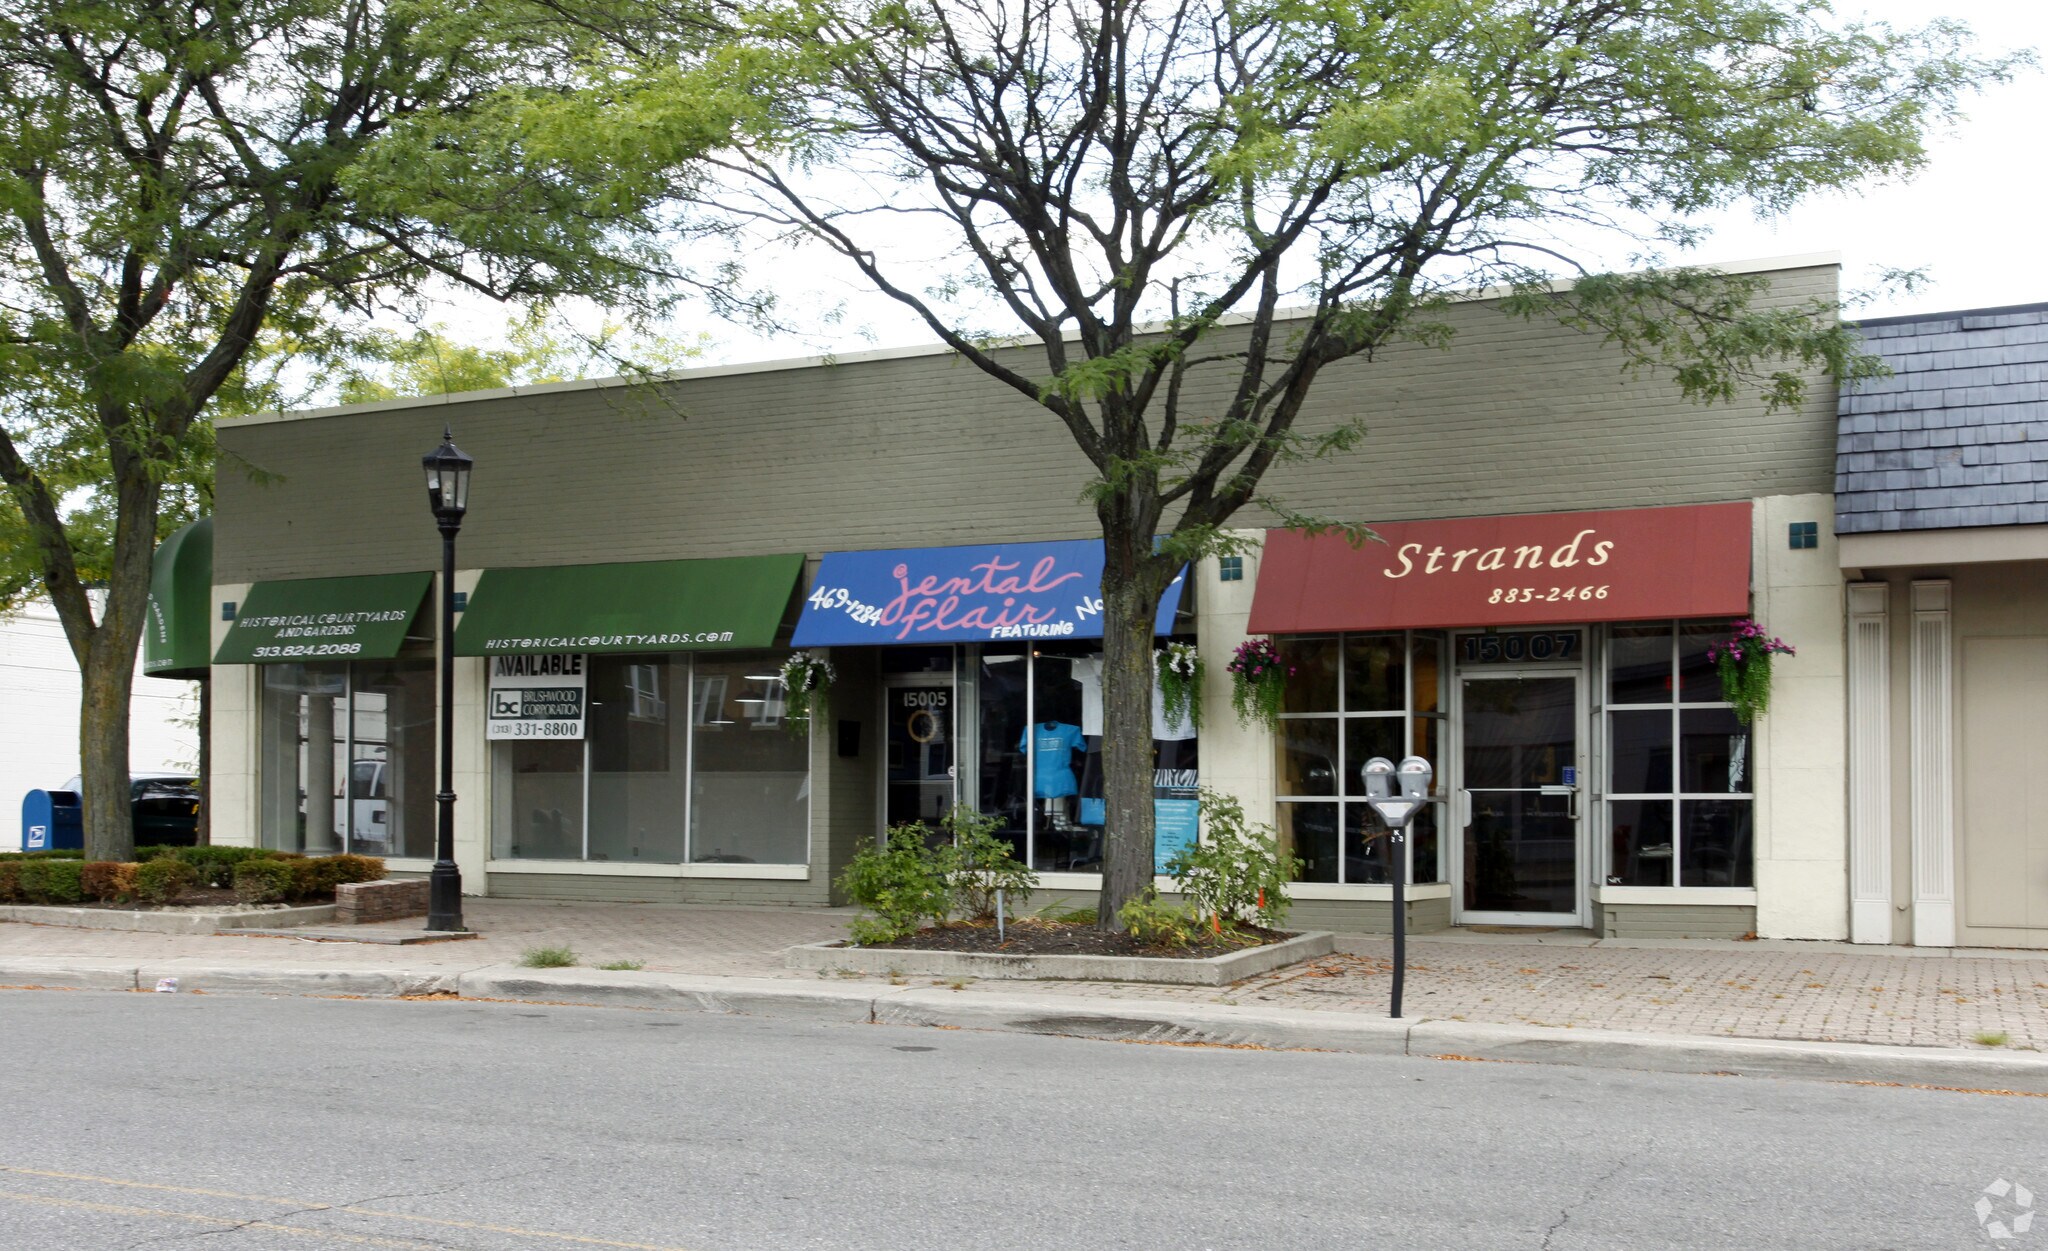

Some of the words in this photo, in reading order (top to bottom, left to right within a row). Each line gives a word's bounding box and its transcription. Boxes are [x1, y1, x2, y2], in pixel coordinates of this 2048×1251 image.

[1383, 529, 1615, 578] Strands
[1487, 585, 1610, 604] 885-2466
[239, 614, 315, 628] HISTORICAL
[317, 610, 407, 625] COURTYARDS
[990, 620, 1075, 639] FEATURING
[252, 643, 362, 658] 313.824.2088
[1464, 634, 1577, 661] 15007
[495, 654, 582, 677] AVAILABLE
[523, 690, 577, 702] BRUSHWOOD
[903, 691, 948, 707] 15005
[522, 703, 580, 716] CORPORATION
[492, 724, 512, 734] (313)
[514, 722, 578, 736] 331-8800
